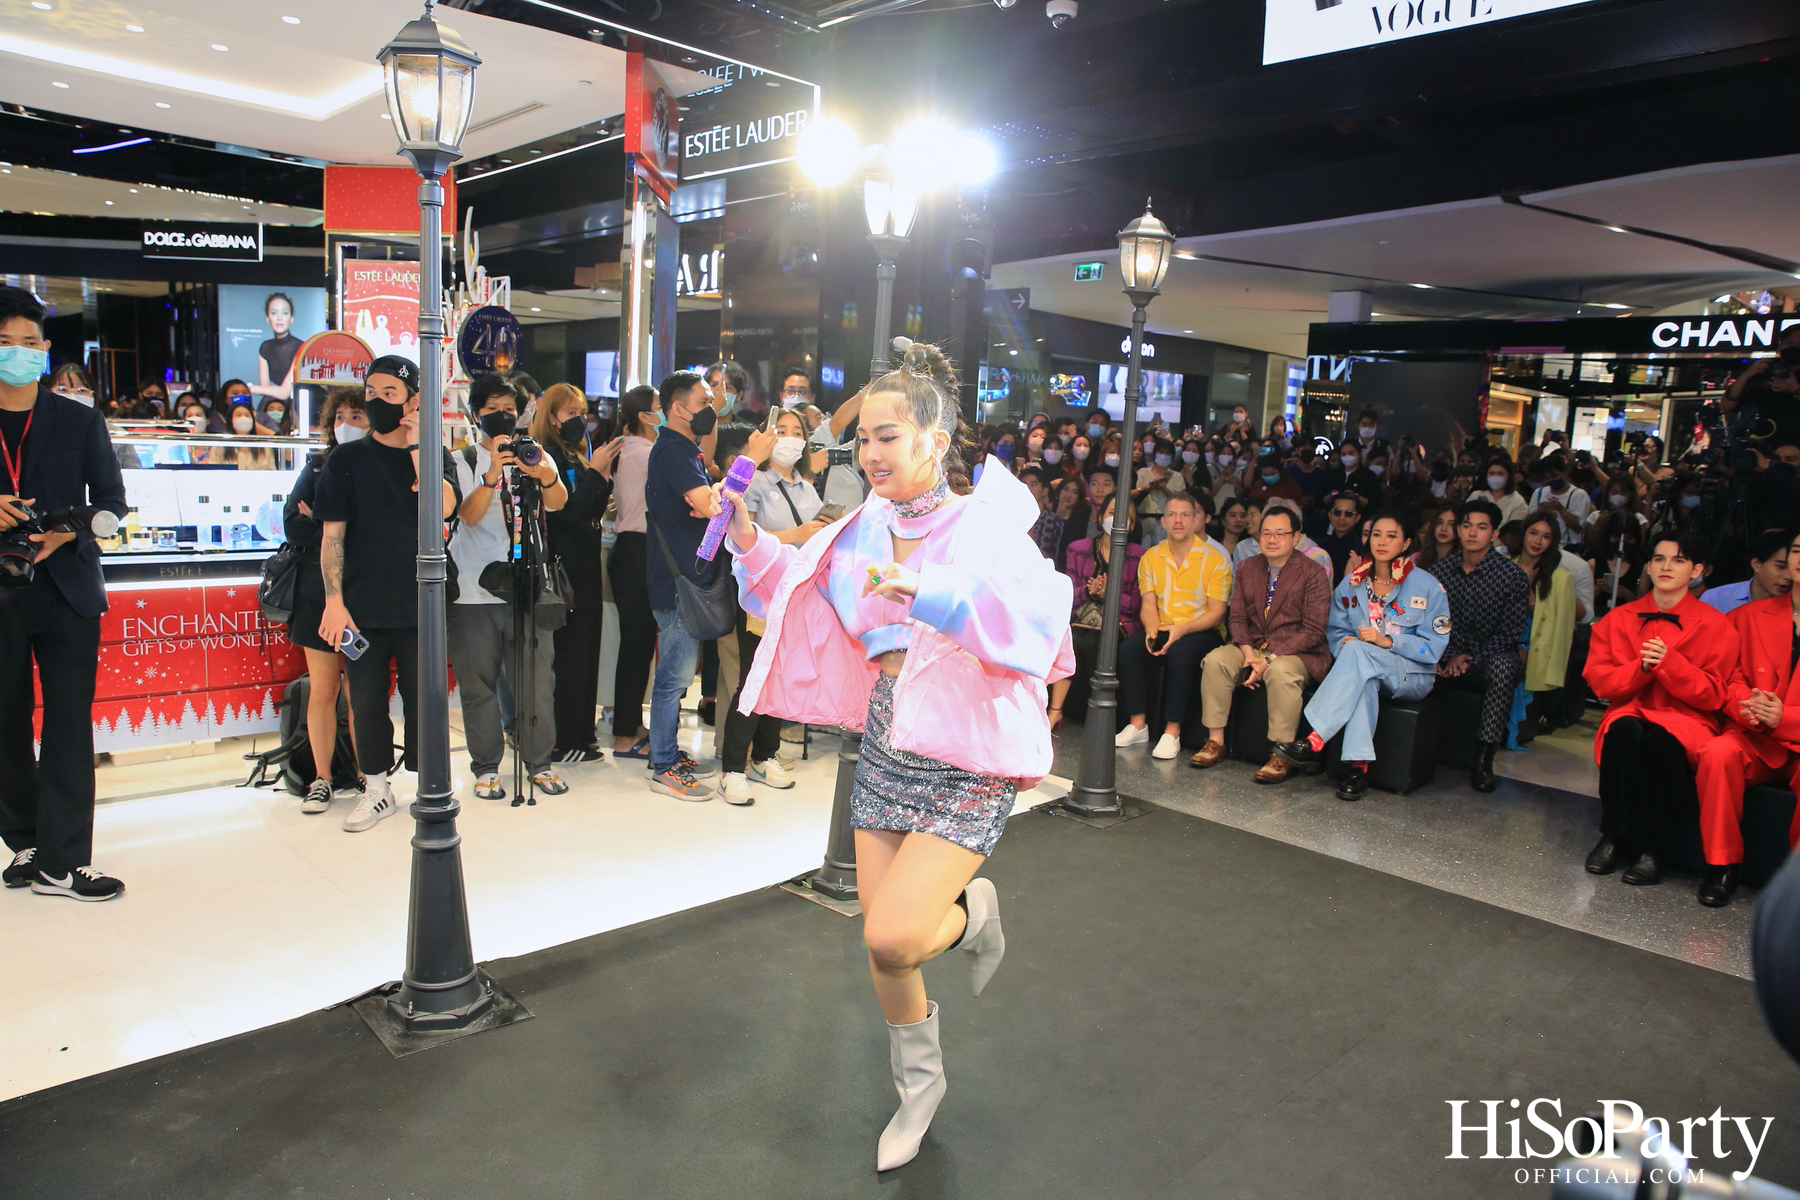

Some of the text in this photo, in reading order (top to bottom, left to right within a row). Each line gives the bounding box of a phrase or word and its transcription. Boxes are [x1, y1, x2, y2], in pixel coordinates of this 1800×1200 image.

[1371, 0, 1493, 34] VOGUE
[736, 109, 808, 148] LAUDER
[385, 270, 421, 285] LAUDE
[1121, 335, 1155, 358] don
[1651, 319, 1800, 348] CHAN
[123, 630, 285, 657] GIFTS OF WONDER
